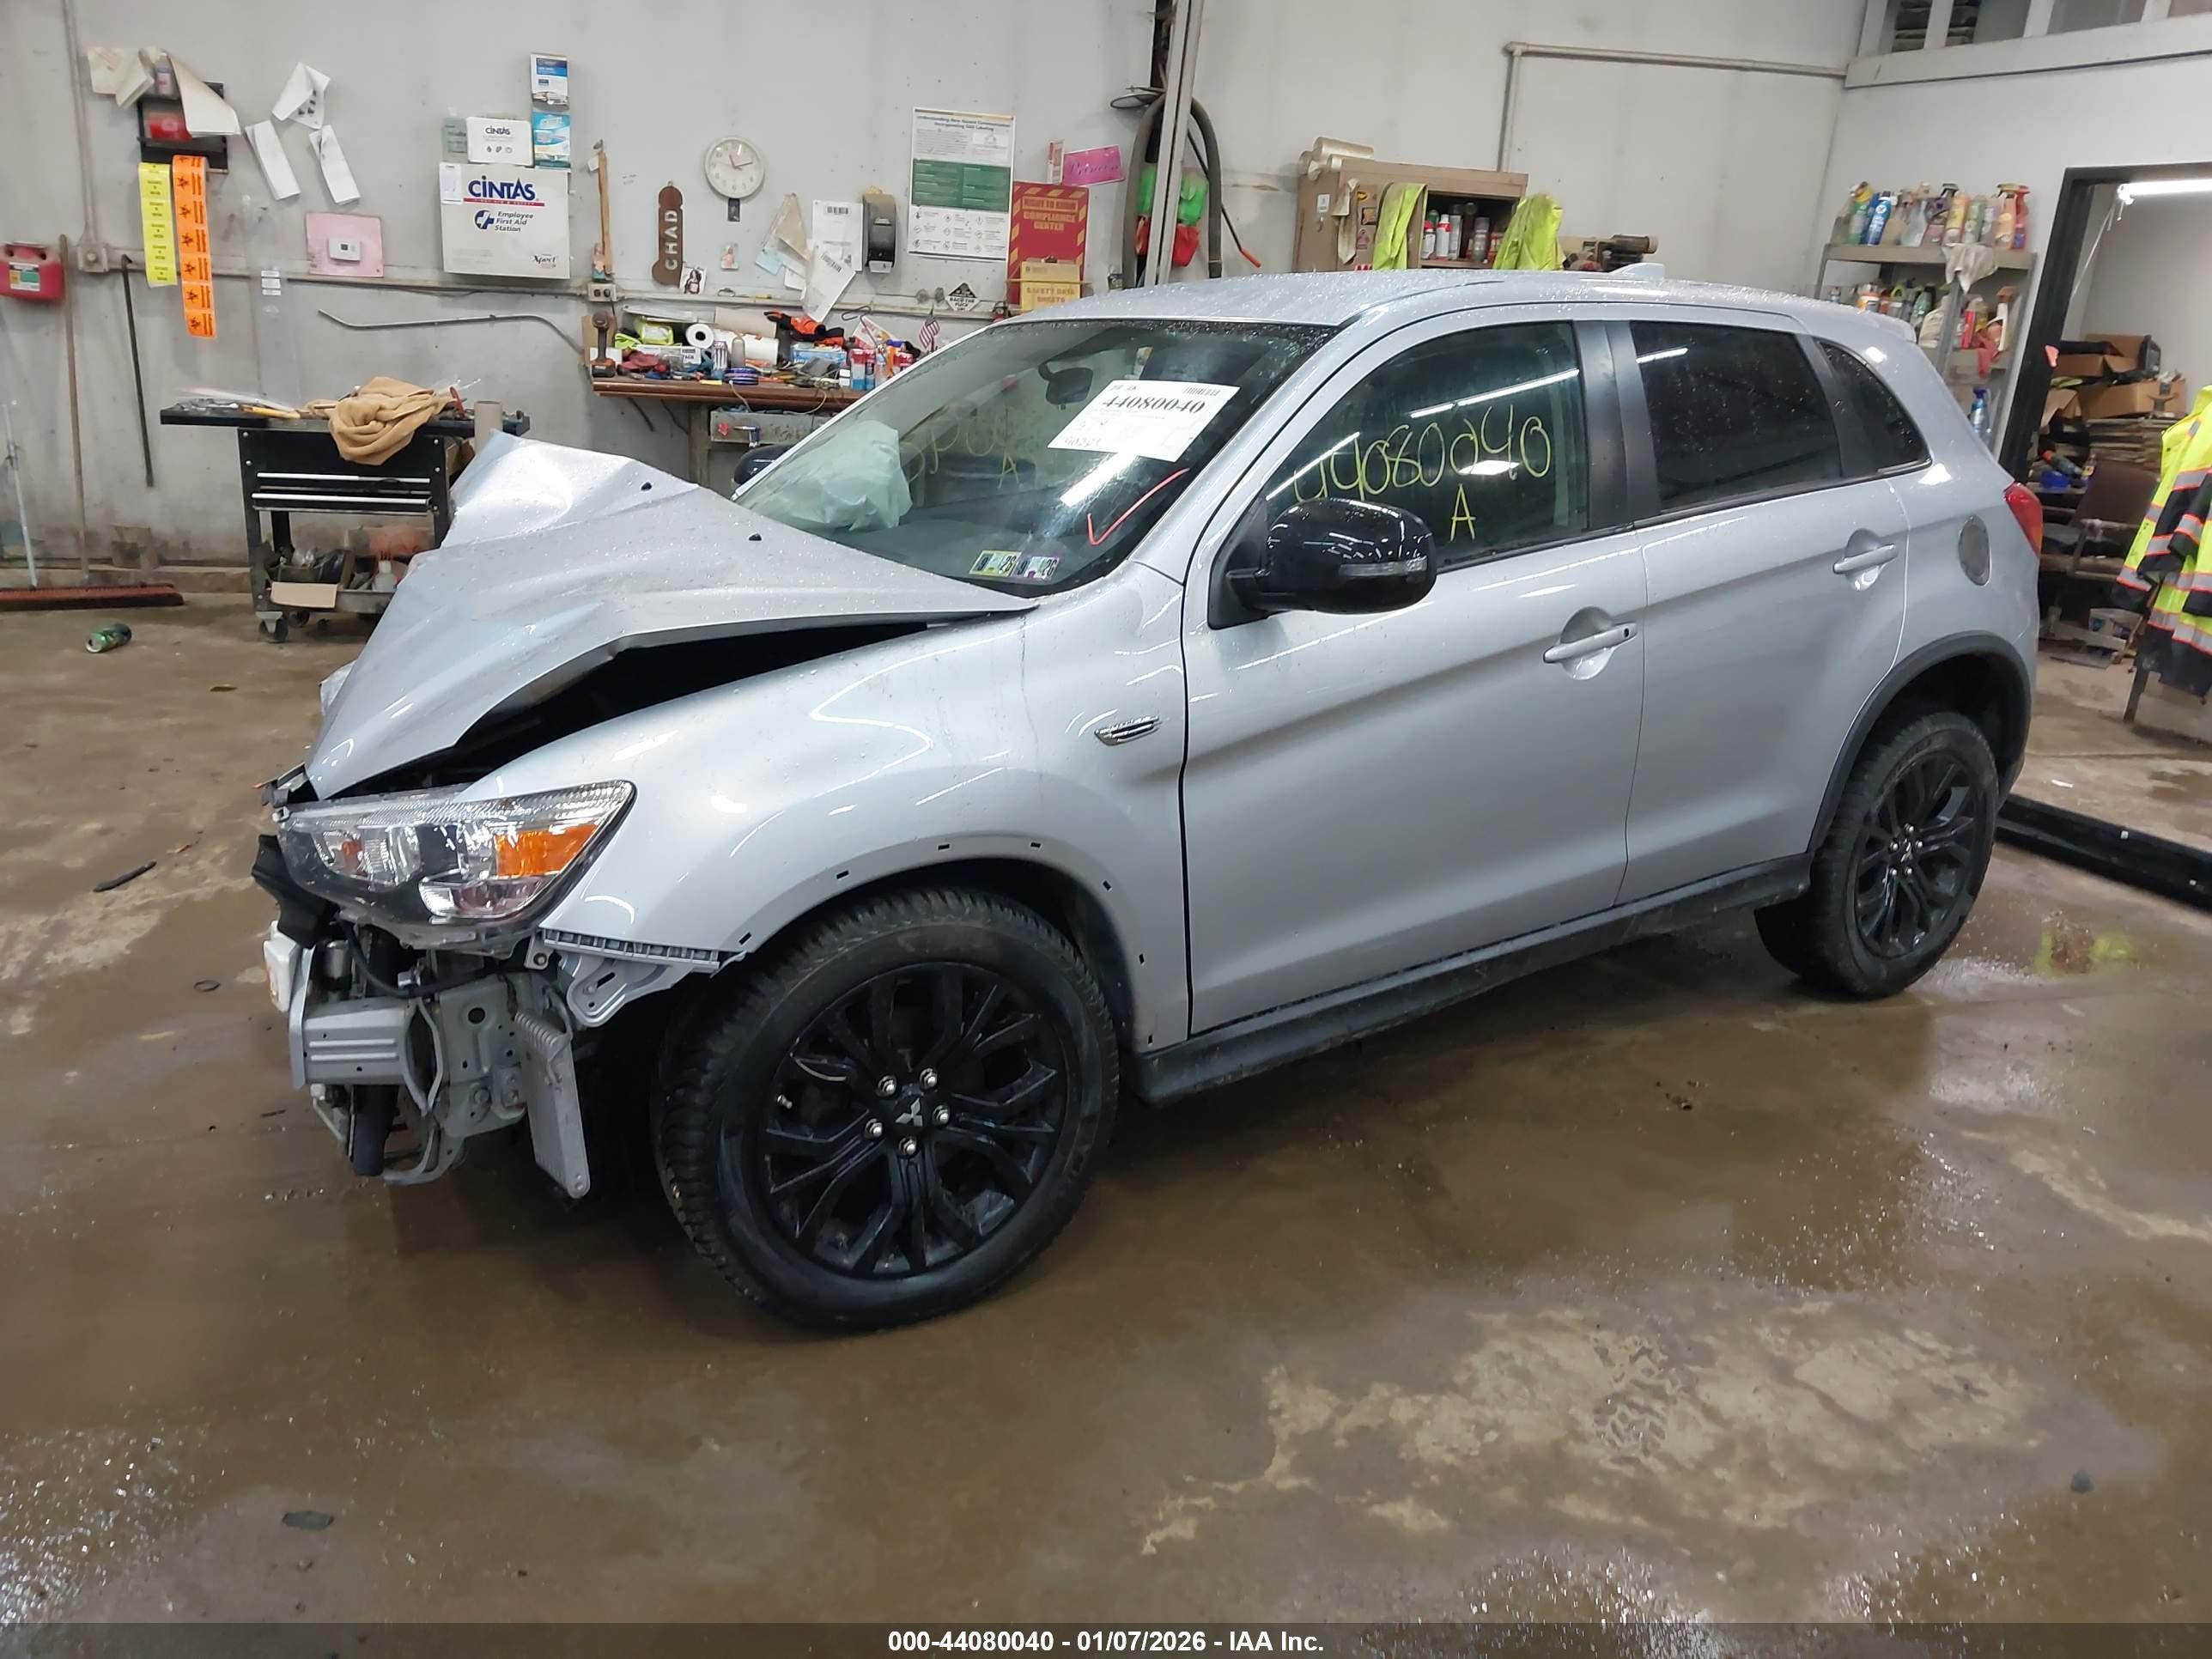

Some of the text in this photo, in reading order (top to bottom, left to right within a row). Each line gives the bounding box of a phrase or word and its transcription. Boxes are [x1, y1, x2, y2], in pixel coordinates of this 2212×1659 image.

[498, 210, 534, 221] Employee
[1023, 211, 1076, 222] COMPLIANCE
[1034, 221, 1065, 231] CENTER
[665, 210, 678, 270] CHAD
[1103, 395, 1206, 414] 44080040
[1292, 404, 1552, 502] 44080040
[1449, 483, 1477, 543] A
